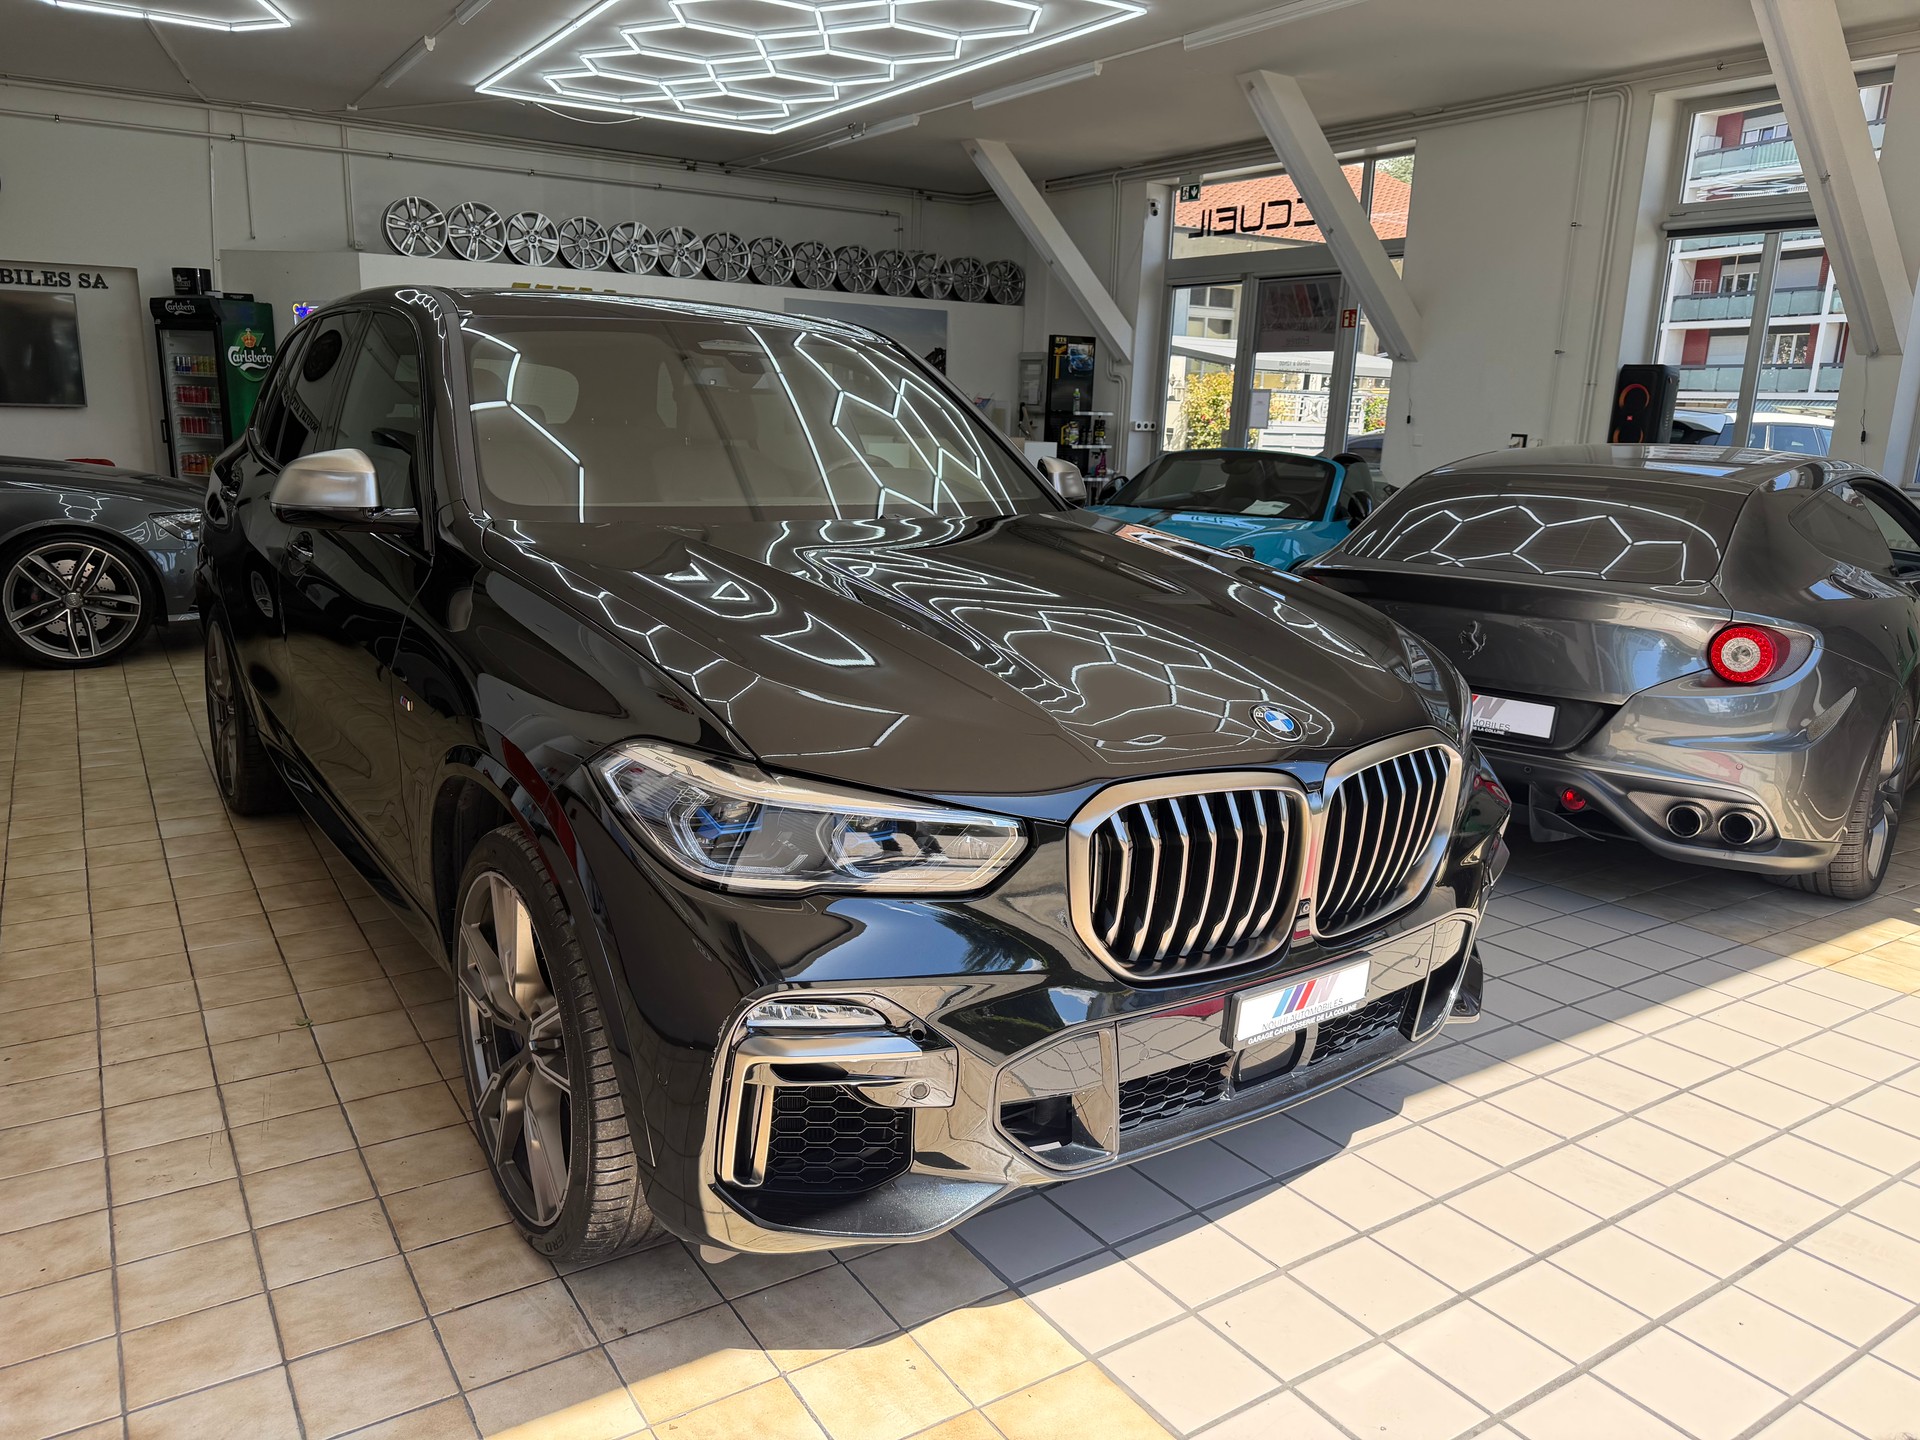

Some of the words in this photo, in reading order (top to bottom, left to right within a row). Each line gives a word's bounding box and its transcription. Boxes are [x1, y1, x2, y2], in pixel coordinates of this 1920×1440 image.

[78, 273, 108, 289] SA
[165, 300, 196, 315] Carlsberg
[228, 346, 272, 369] Carlsberg
[1289, 998, 1344, 1022] AUTOMOBILES
[1247, 1030, 1274, 1045] GARAGE
[1274, 1017, 1316, 1035] CARROSSERIE
[1316, 1013, 1325, 1022] DE
[1325, 1010, 1334, 1019] LA
[1333, 1003, 1358, 1017] COLLINE
